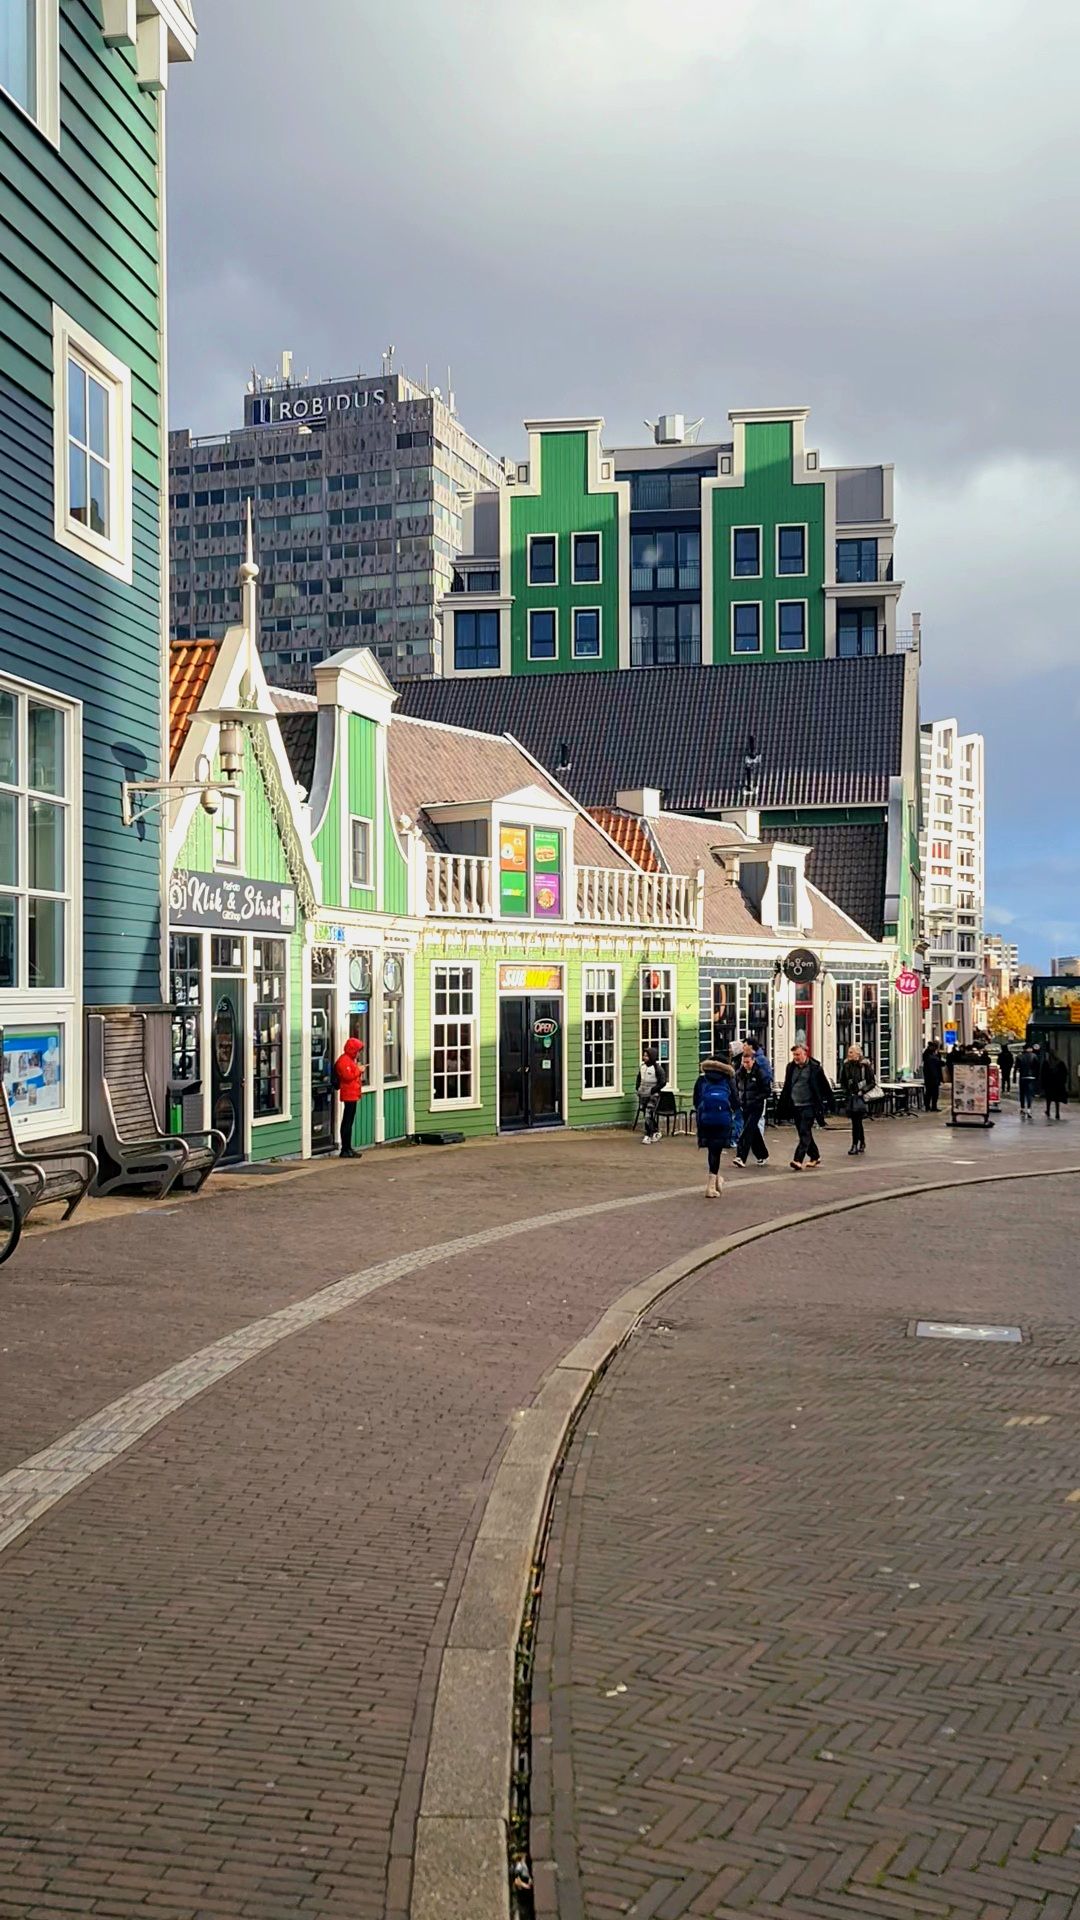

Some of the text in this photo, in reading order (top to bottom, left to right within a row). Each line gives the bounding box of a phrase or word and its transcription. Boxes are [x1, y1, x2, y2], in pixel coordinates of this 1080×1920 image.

[279, 389, 385, 420] ROBIDUS
[187, 876, 281, 920] Klik & Strik
[534, 1023, 555, 1033] OPEN
